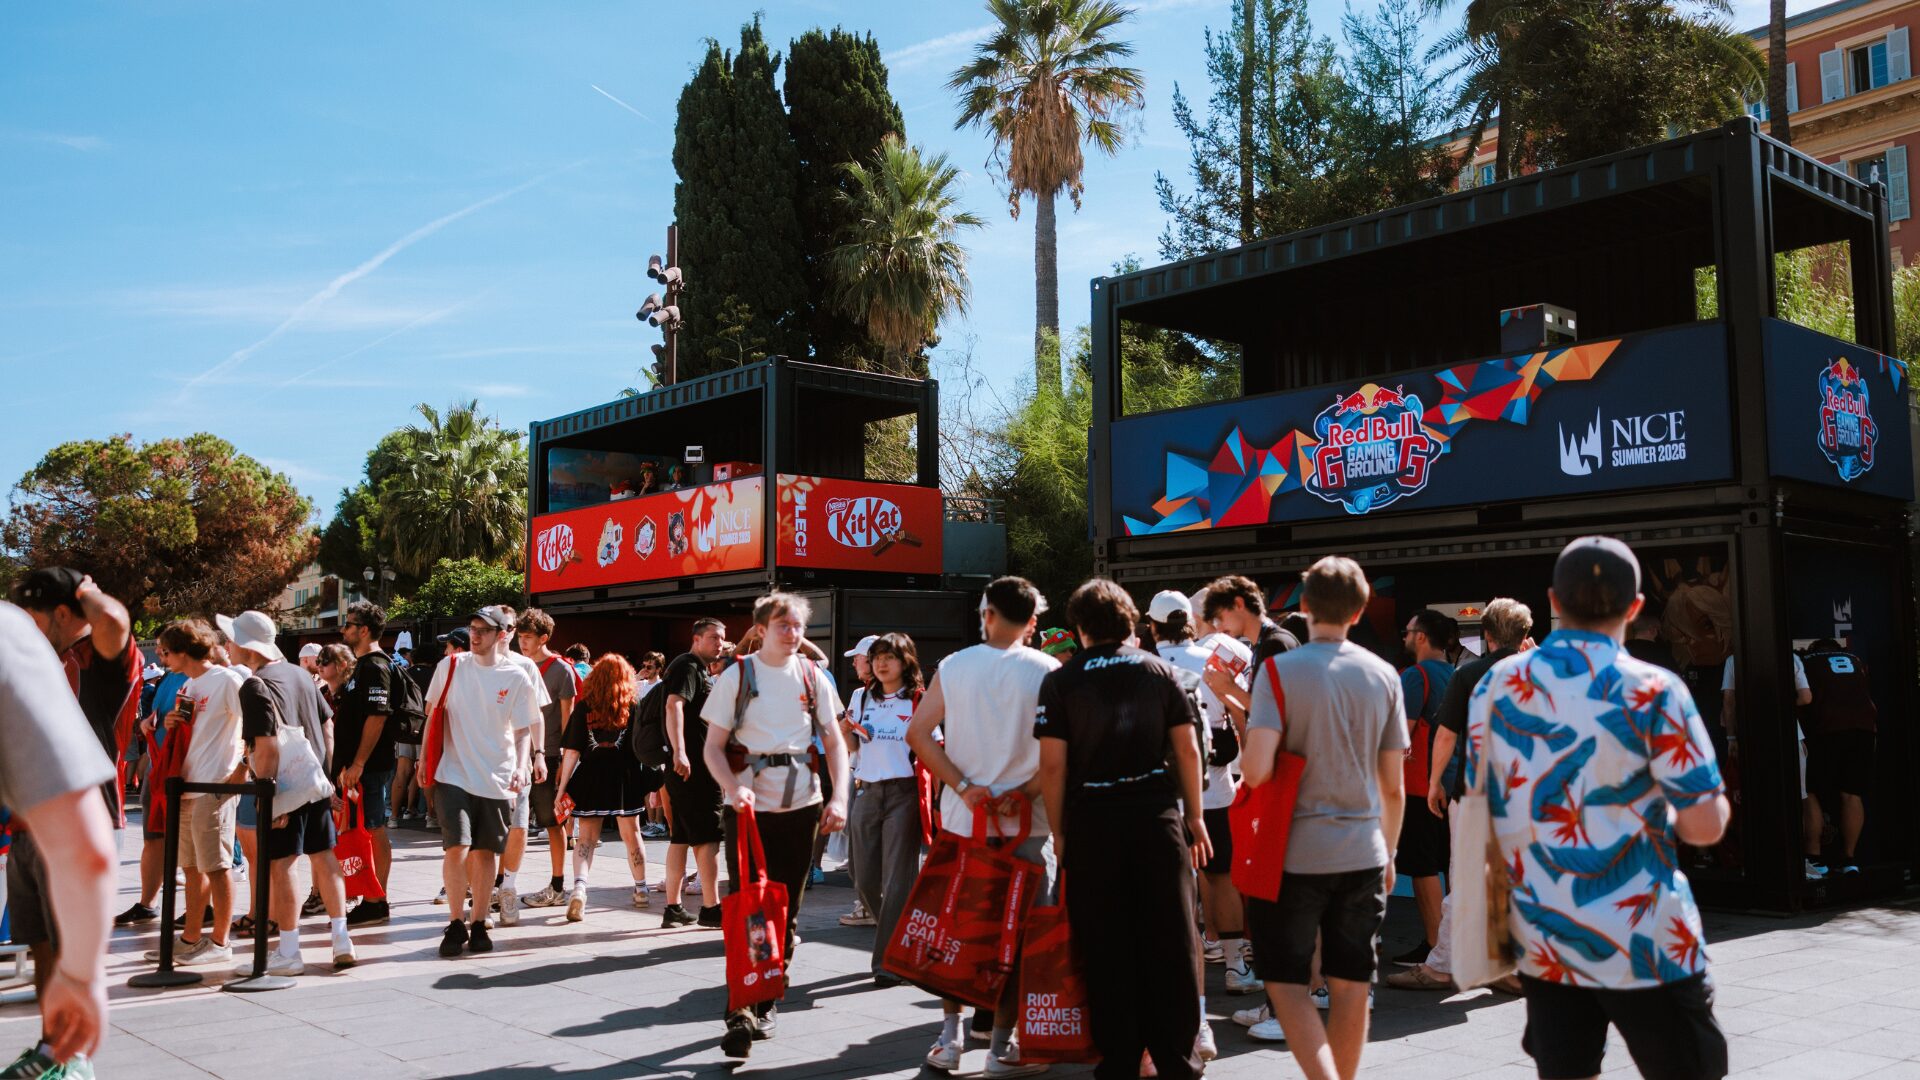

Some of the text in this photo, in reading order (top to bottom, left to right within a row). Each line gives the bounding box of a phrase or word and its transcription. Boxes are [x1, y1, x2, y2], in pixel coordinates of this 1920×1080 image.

[1826, 386, 1867, 418] Red Bull
[1328, 411, 1414, 447] Red Bull
[1611, 410, 1686, 448] NICE
[1836, 414, 1859, 431] GAMING
[1838, 428, 1860, 448] GROUND
[1346, 442, 1396, 464] GAMING
[1611, 442, 1687, 468] SUMMER 2026
[1346, 457, 1398, 479] GROUND
[720, 507, 752, 533] NICE
[836, 498, 899, 546] KitKat
[541, 525, 572, 571] KitKat
[1828, 656, 1854, 673] 8
[1027, 993, 1058, 1007] RIOT
[1026, 1007, 1082, 1022] GAMES
[1025, 1021, 1082, 1036] MERCH
